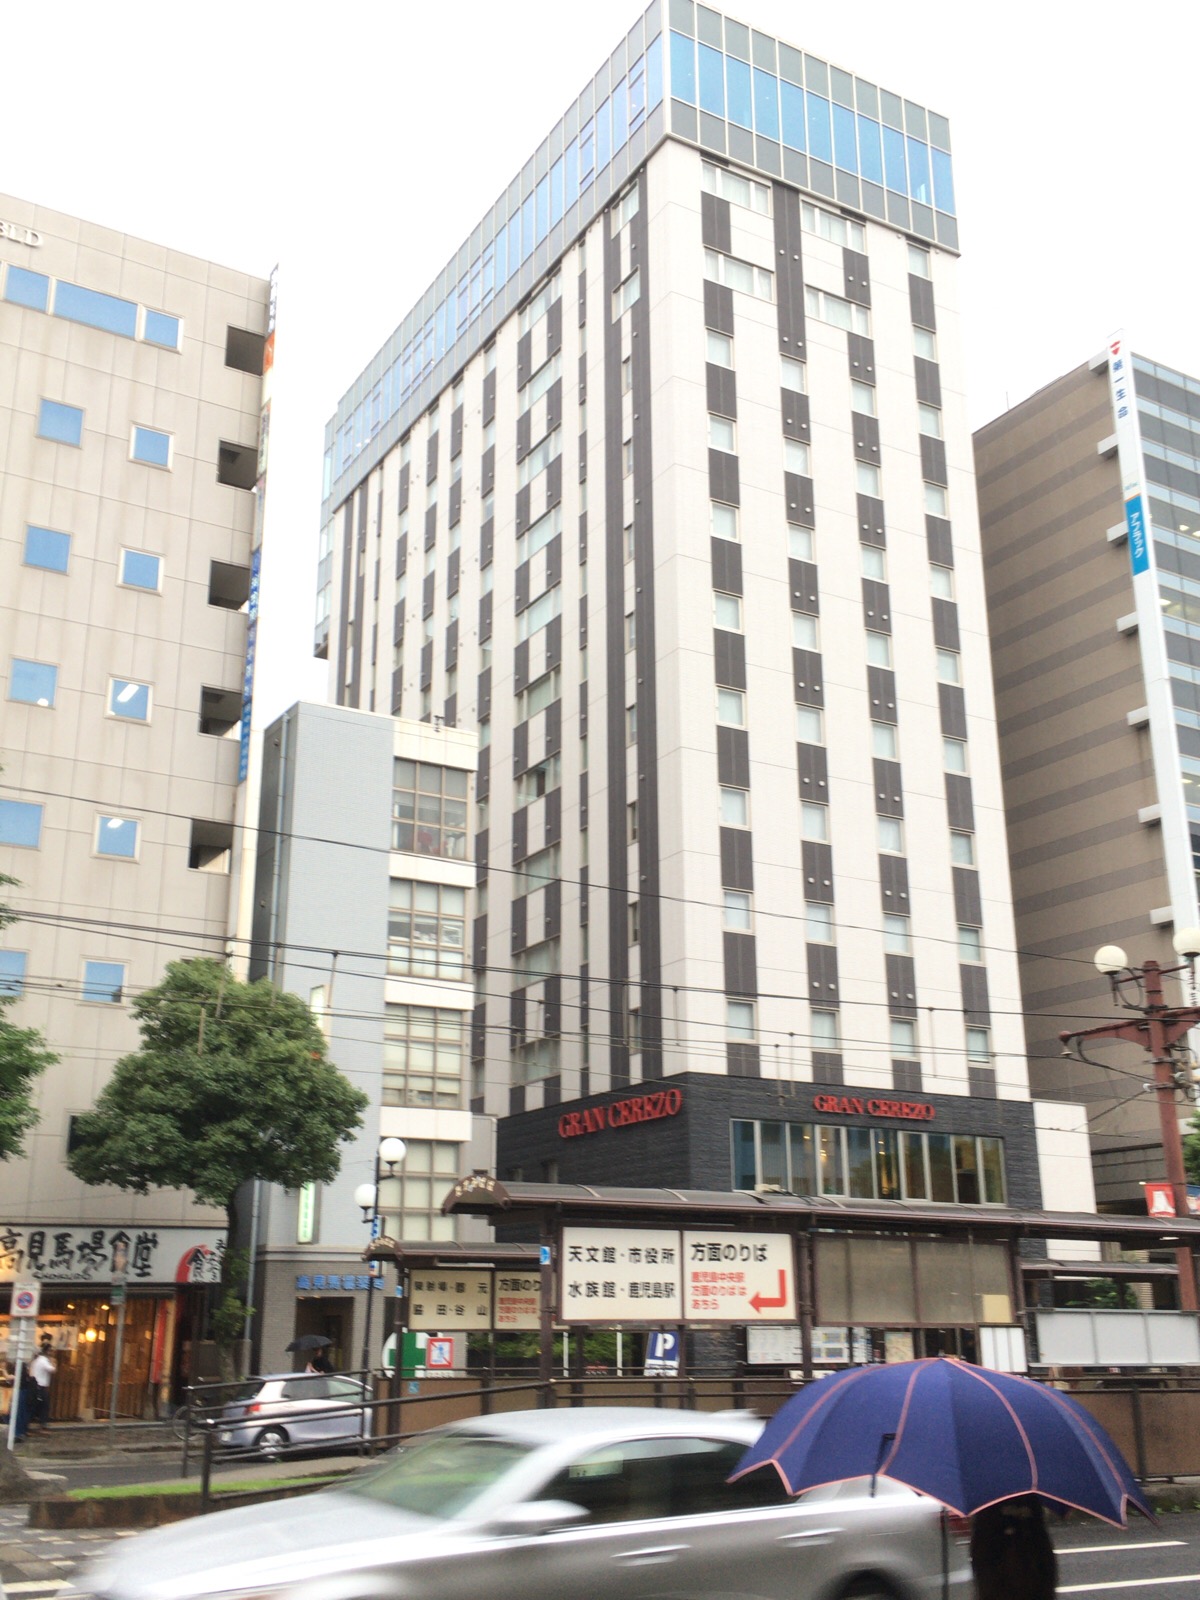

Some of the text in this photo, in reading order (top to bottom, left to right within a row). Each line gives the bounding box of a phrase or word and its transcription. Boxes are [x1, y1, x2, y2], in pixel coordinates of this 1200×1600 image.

[558, 1088, 682, 1138] GRAN CEREZO
[813, 1095, 936, 1120] GRAN CEREZO
[568, 1245, 675, 1265] 天文館・市役所
[690, 1242, 768, 1262] 方面のりば
[691, 1271, 746, 1284] 鹿児島中央駅
[567, 1281, 676, 1299] 水族館・鹿児島駅
[691, 1285, 747, 1297] 方面のりばは
[655, 1333, 675, 1357] P
